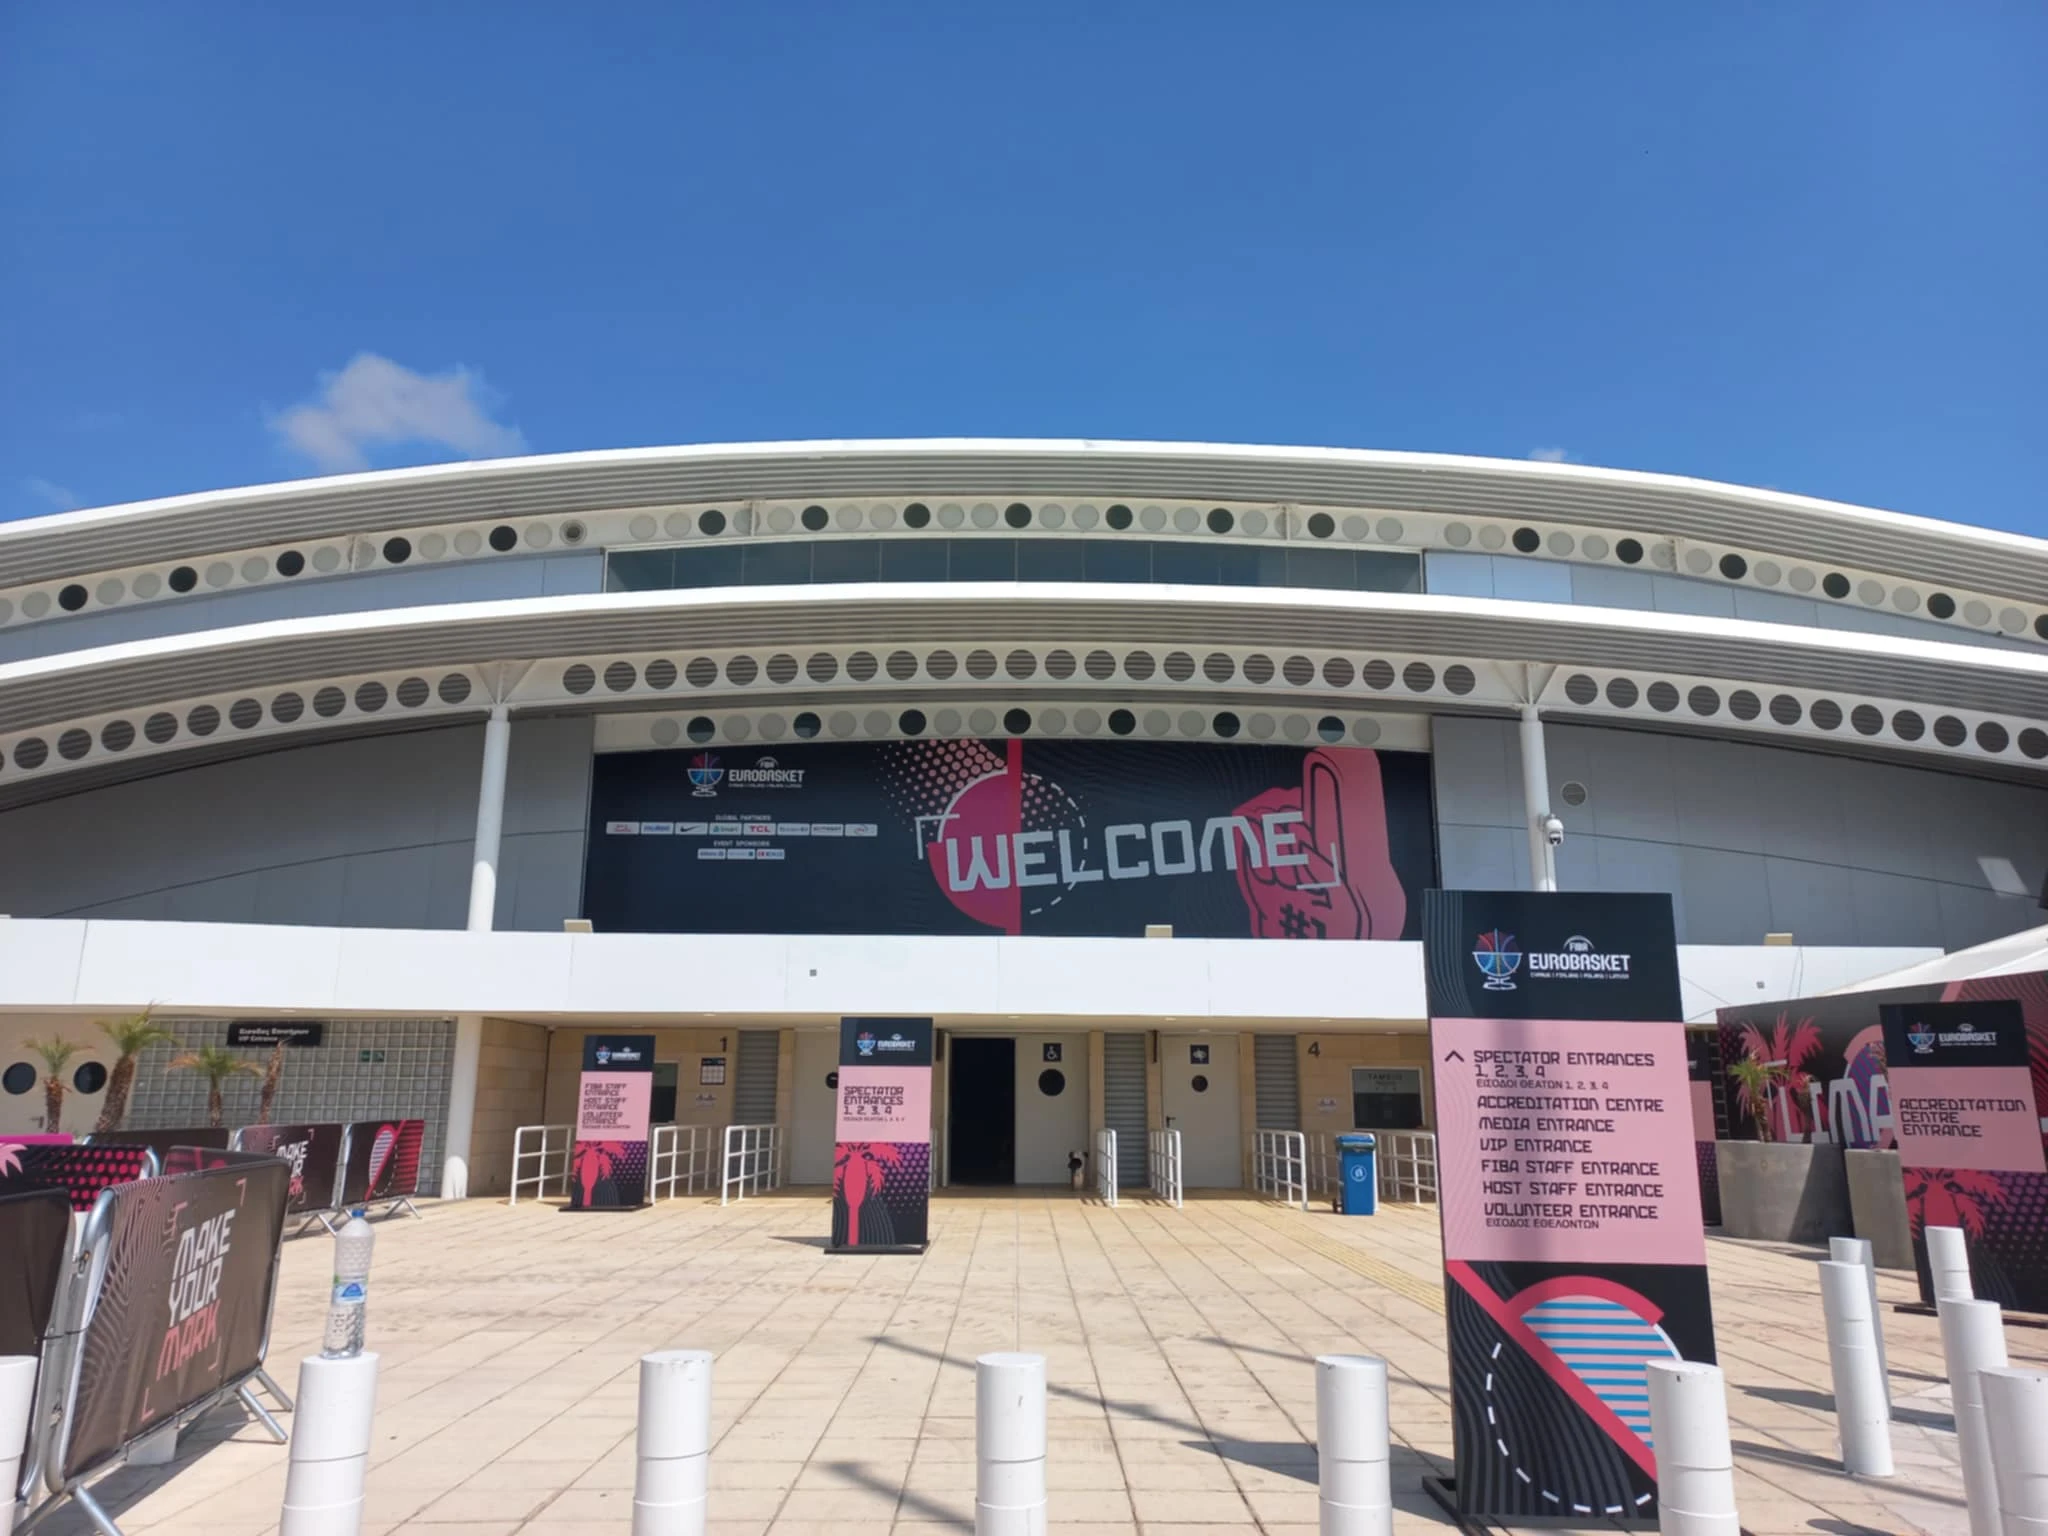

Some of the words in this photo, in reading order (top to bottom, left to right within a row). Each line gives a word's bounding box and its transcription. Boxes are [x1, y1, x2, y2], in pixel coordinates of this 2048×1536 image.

[728, 769, 805, 782] EUROBASKET
[750, 825, 771, 833] TCL
[946, 811, 1309, 892] WELCOME
[1569, 942, 1588, 951] FIBA
[1529, 953, 1631, 971] EUROBASKET
[720, 1036, 728, 1052] 1
[1308, 1041, 1320, 1057] 4
[1474, 1051, 1560, 1065] SPECTATOR
[1567, 1052, 1655, 1066] ENTRANCES
[1475, 1064, 1488, 1078] 1,
[1515, 1065, 1528, 1079] 3,
[1536, 1066, 1545, 1078] 4
[844, 1086, 904, 1096] SPECTATOR
[843, 1096, 904, 1106] ENTRANCES
[1477, 1096, 1599, 1111] ACCREDITATION
[1606, 1098, 1664, 1112] CENTRE
[1900, 1098, 2027, 1112] ACCREDITATION
[1479, 1117, 1530, 1130] MEDIA
[1537, 1118, 1615, 1132] ENTRANCE
[1901, 1111, 1960, 1123] CENTRE
[1902, 1124, 1982, 1137] ENTRANCE
[276, 1141, 309, 1160] MAKE
[1480, 1138, 1508, 1151] VIP
[1514, 1139, 1592, 1153] ENTRANCE
[1481, 1160, 1519, 1173] FIBA
[1526, 1160, 1574, 1174] STAFF
[1582, 1162, 1660, 1176] ENTRANCE
[1483, 1181, 1522, 1195] HOST
[1530, 1182, 1578, 1196] STAFF
[1585, 1183, 1664, 1198] ENTRANCE
[1484, 1202, 1572, 1217] VOLUNTEER
[1580, 1204, 1658, 1219] ENTRANCE
[172, 1209, 235, 1280] MAKE
[168, 1257, 223, 1328] YOUR
[156, 1299, 220, 1381] MARK
